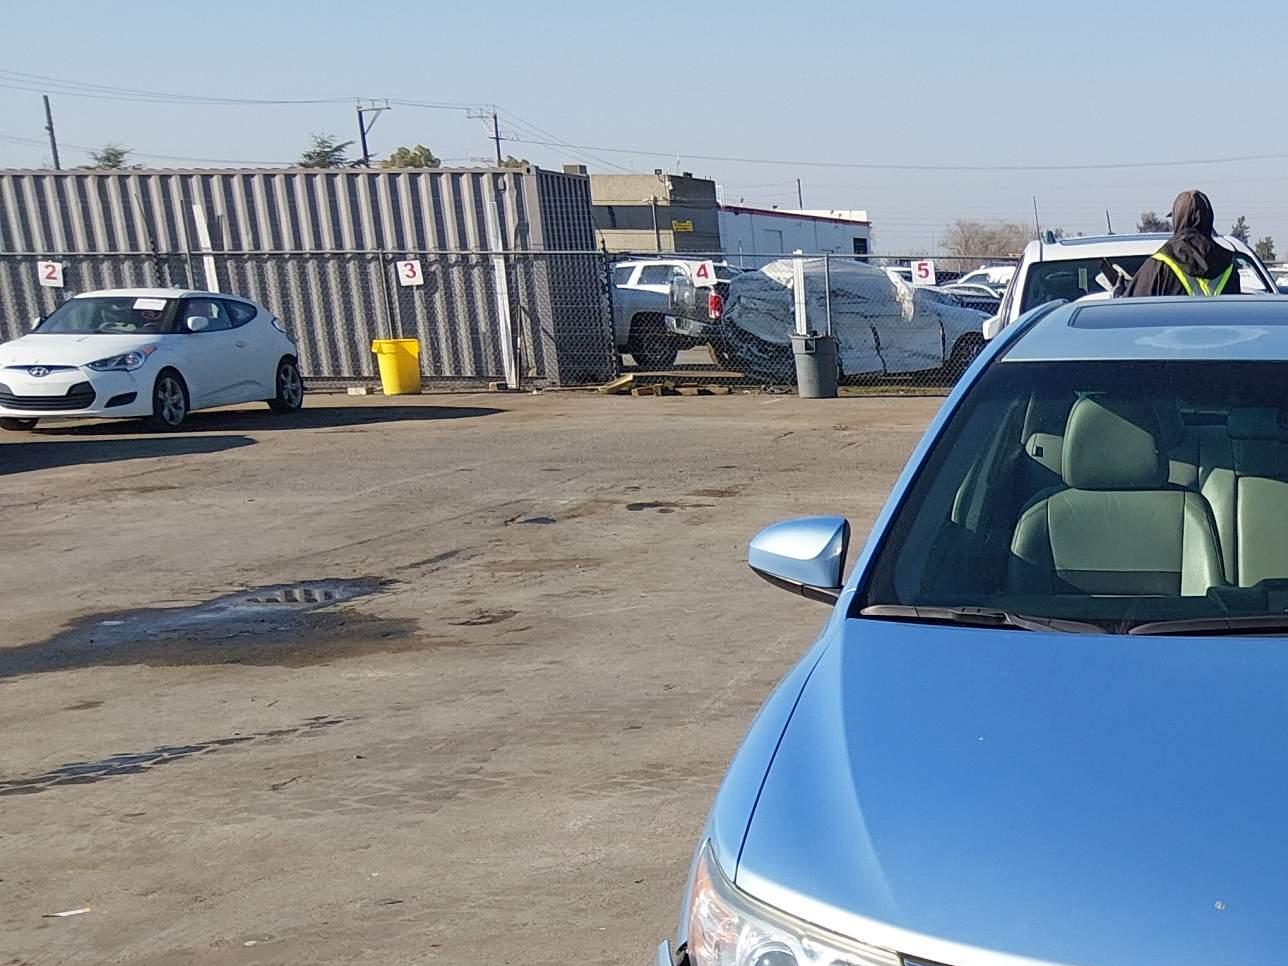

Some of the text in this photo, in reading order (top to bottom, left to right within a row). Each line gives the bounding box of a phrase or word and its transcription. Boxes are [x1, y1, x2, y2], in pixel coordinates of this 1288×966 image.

[45, 264, 57, 280] 2
[405, 262, 416, 279] 3
[697, 263, 709, 279] 4
[918, 262, 930, 279] 5
